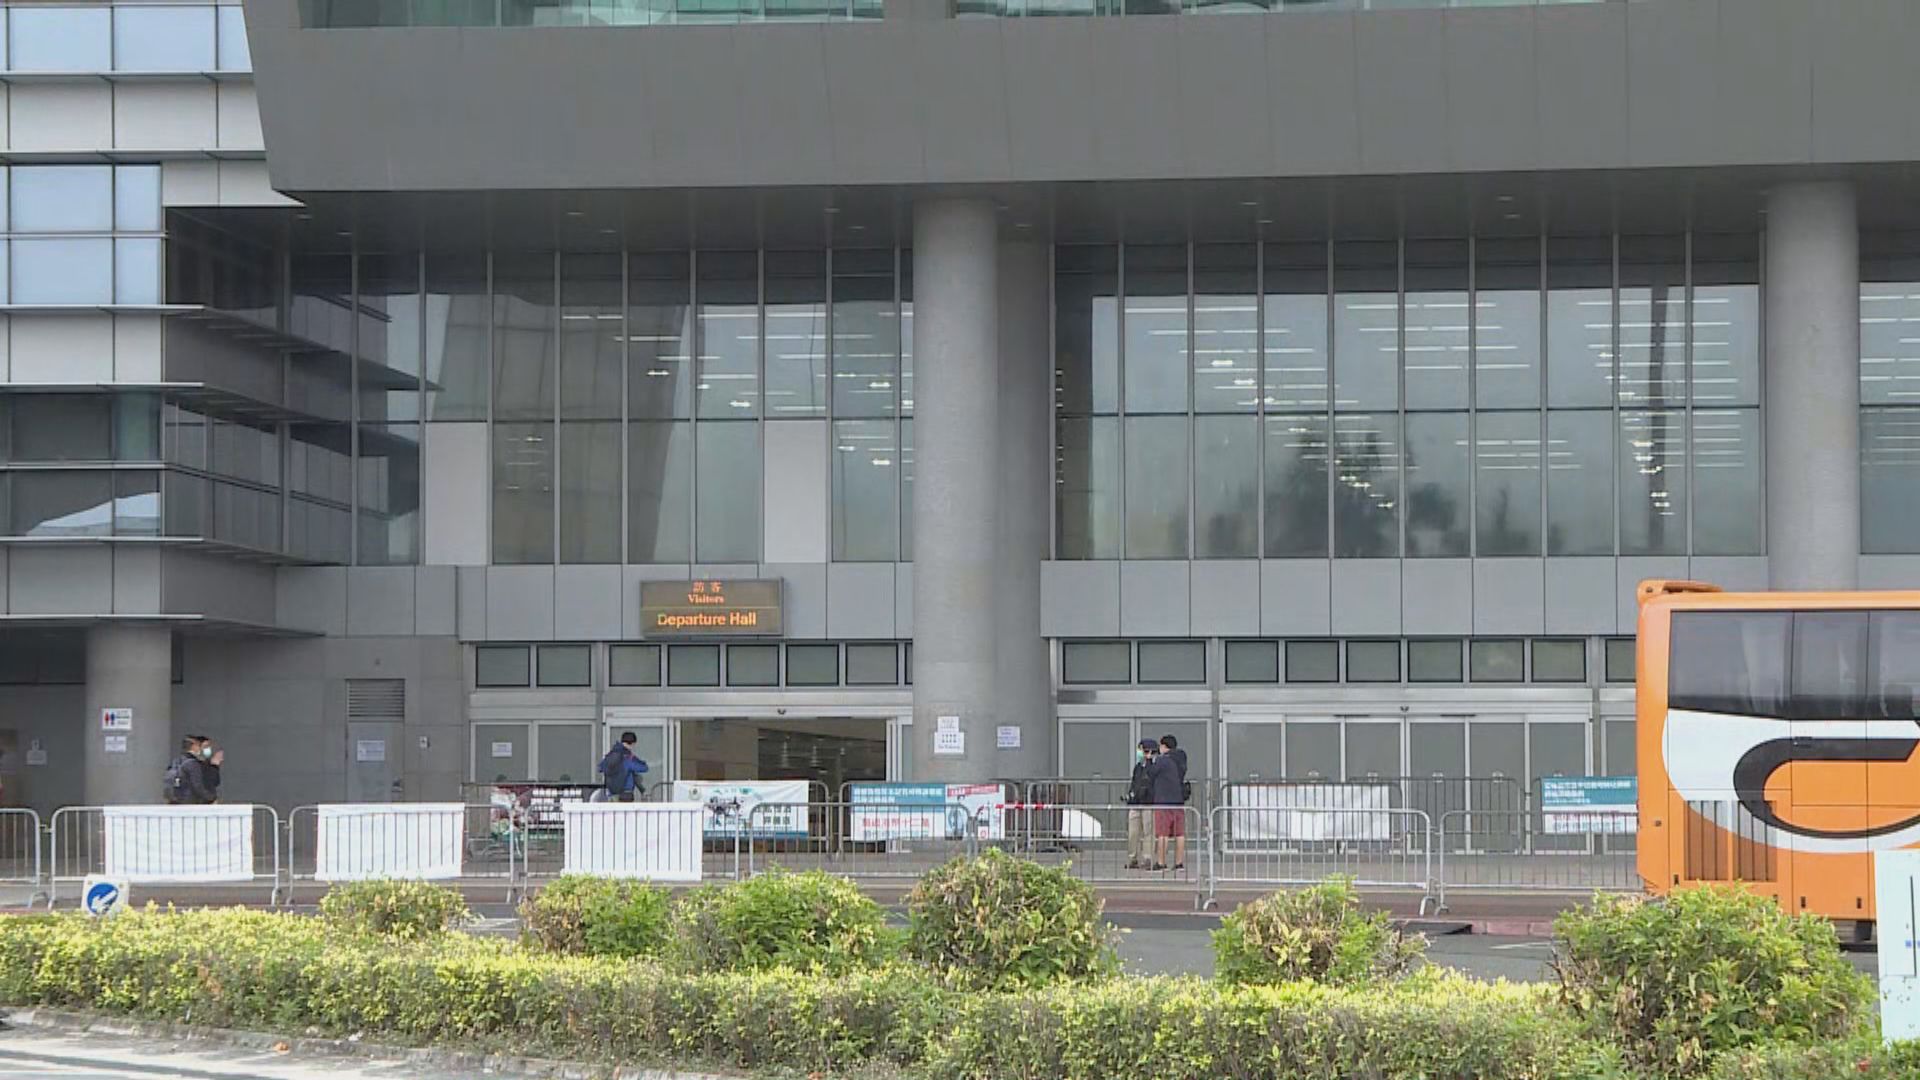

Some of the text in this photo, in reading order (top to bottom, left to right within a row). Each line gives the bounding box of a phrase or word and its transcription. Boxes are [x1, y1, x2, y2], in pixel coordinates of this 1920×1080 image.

[687, 594, 725, 603] Visitors
[657, 612, 757, 629] Departure Hall
